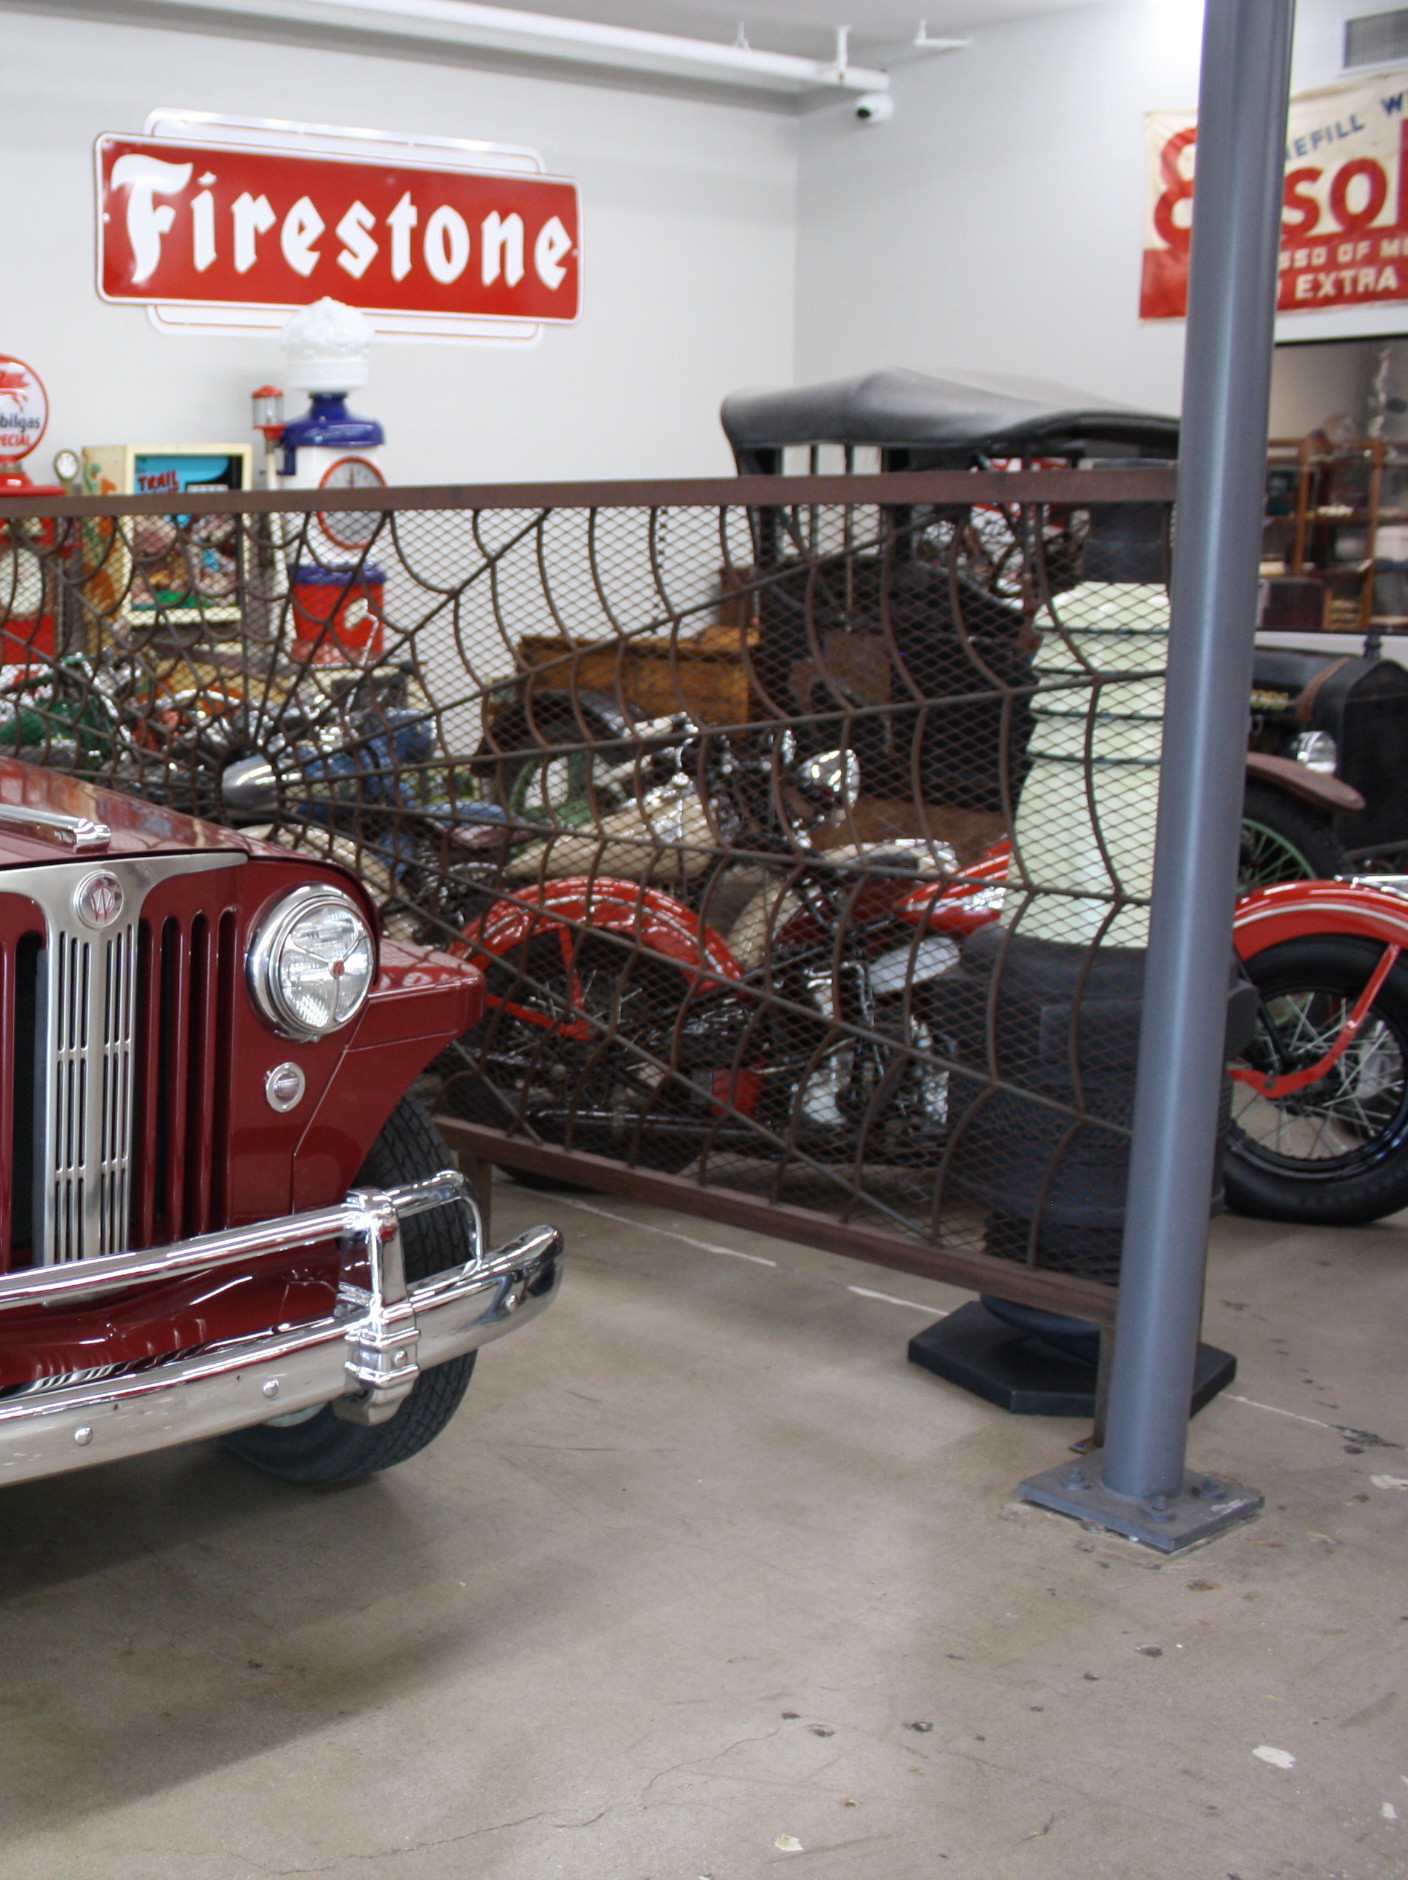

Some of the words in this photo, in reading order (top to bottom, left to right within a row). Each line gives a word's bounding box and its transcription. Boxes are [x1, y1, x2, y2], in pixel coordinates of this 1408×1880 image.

[1285, 113, 1366, 162] EFILL
[110, 153, 573, 291] Firestone
[1336, 240, 1372, 265] OF
[1295, 264, 1400, 301] EXTRA
